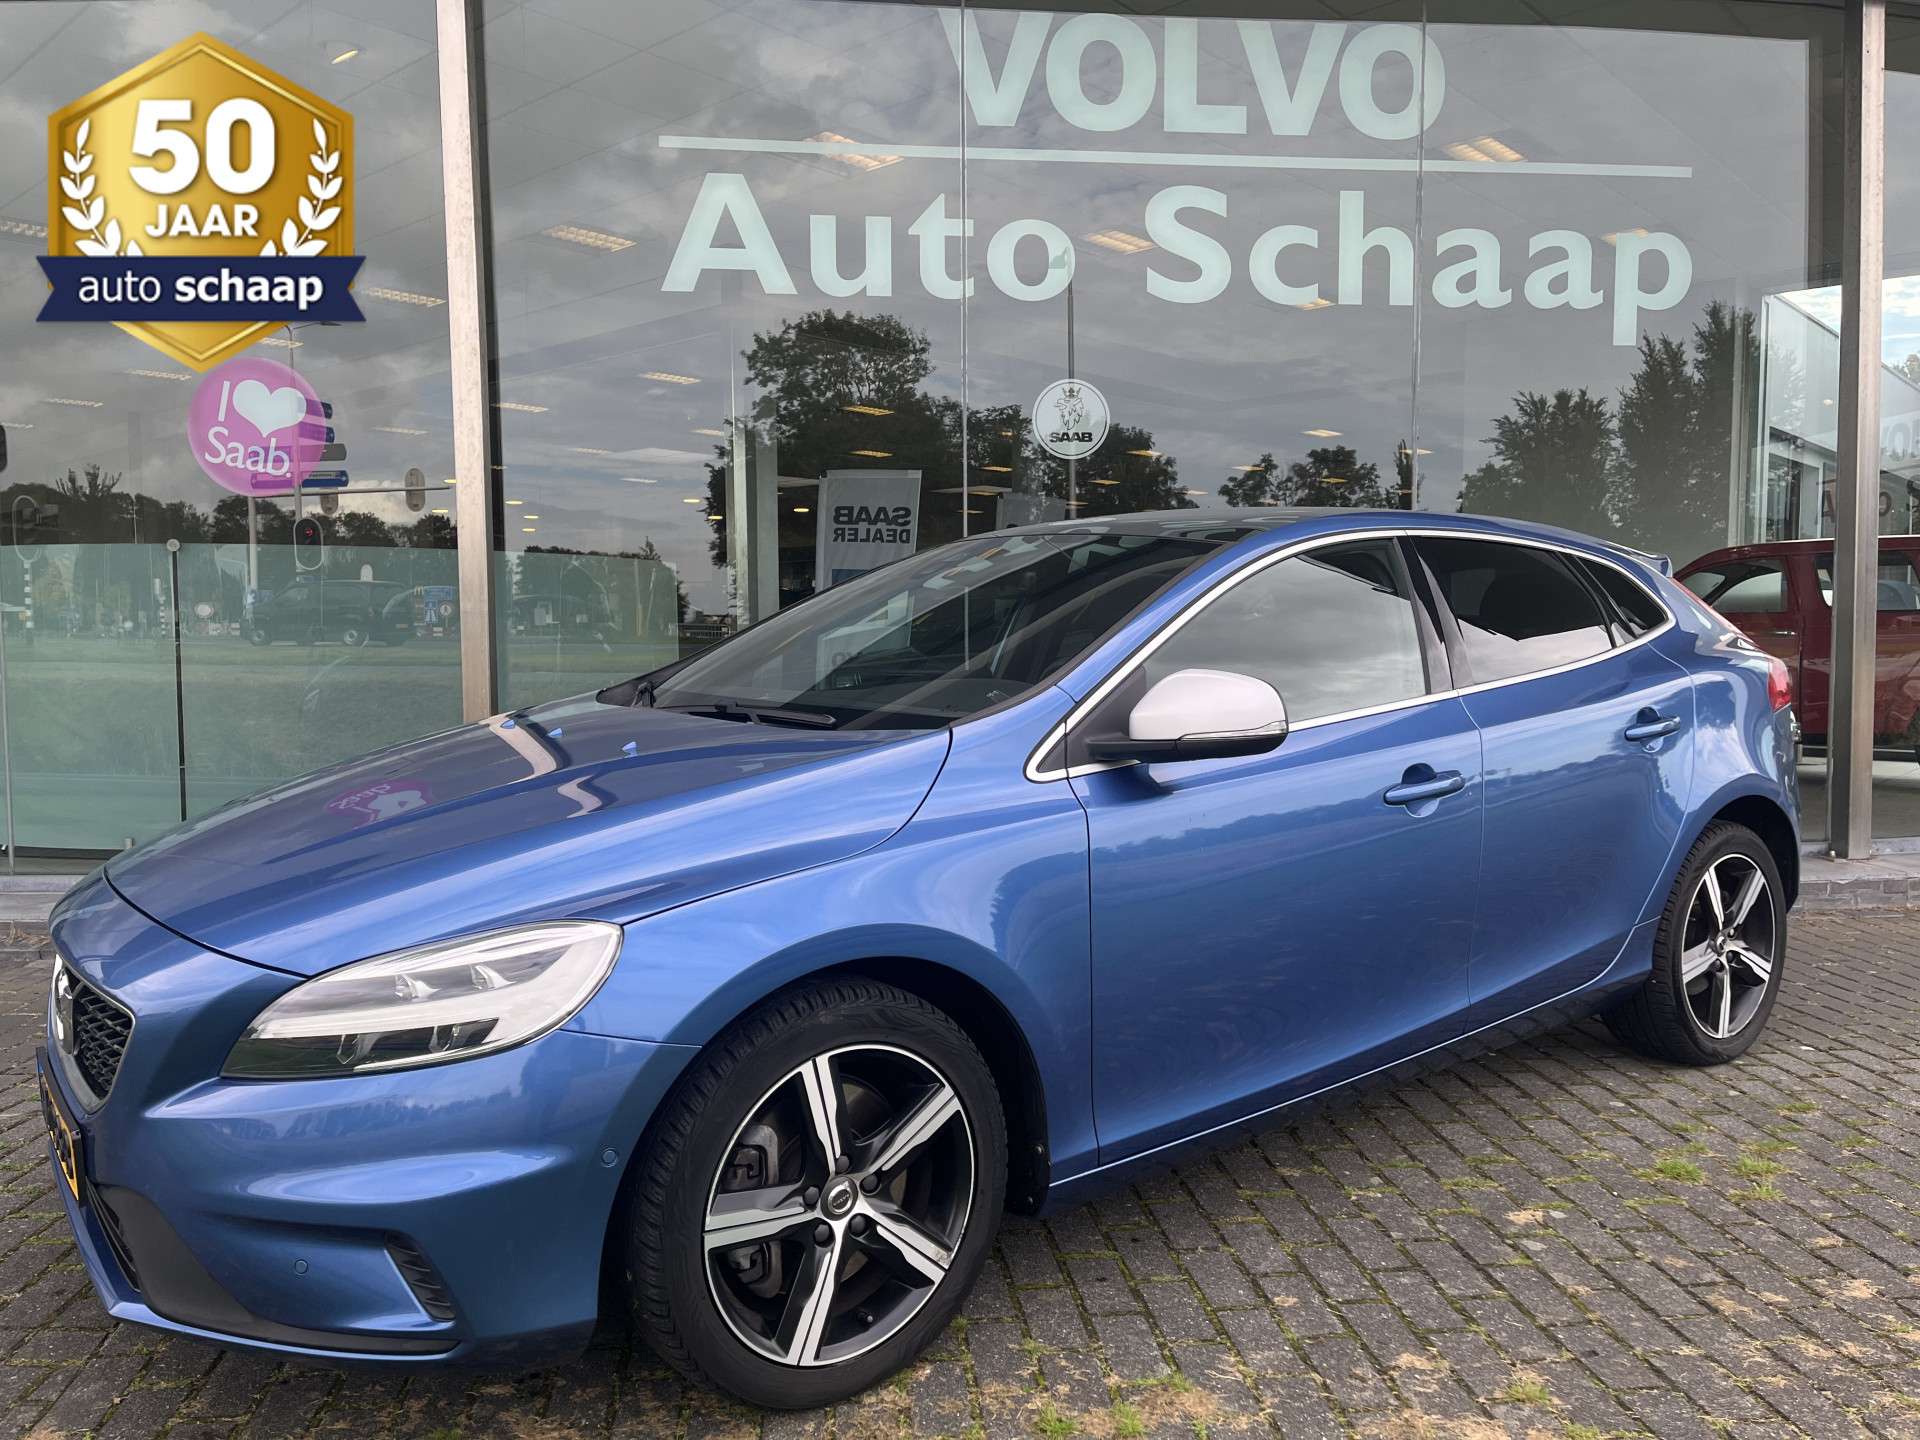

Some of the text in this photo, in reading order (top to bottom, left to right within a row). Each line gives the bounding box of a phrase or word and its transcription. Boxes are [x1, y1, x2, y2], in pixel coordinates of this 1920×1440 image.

[937, 9, 1446, 140] VOLVO
[660, 172, 1693, 346] Auto Schaap
[217, 380, 231, 423] I
[1049, 431, 1093, 443] SAAB
